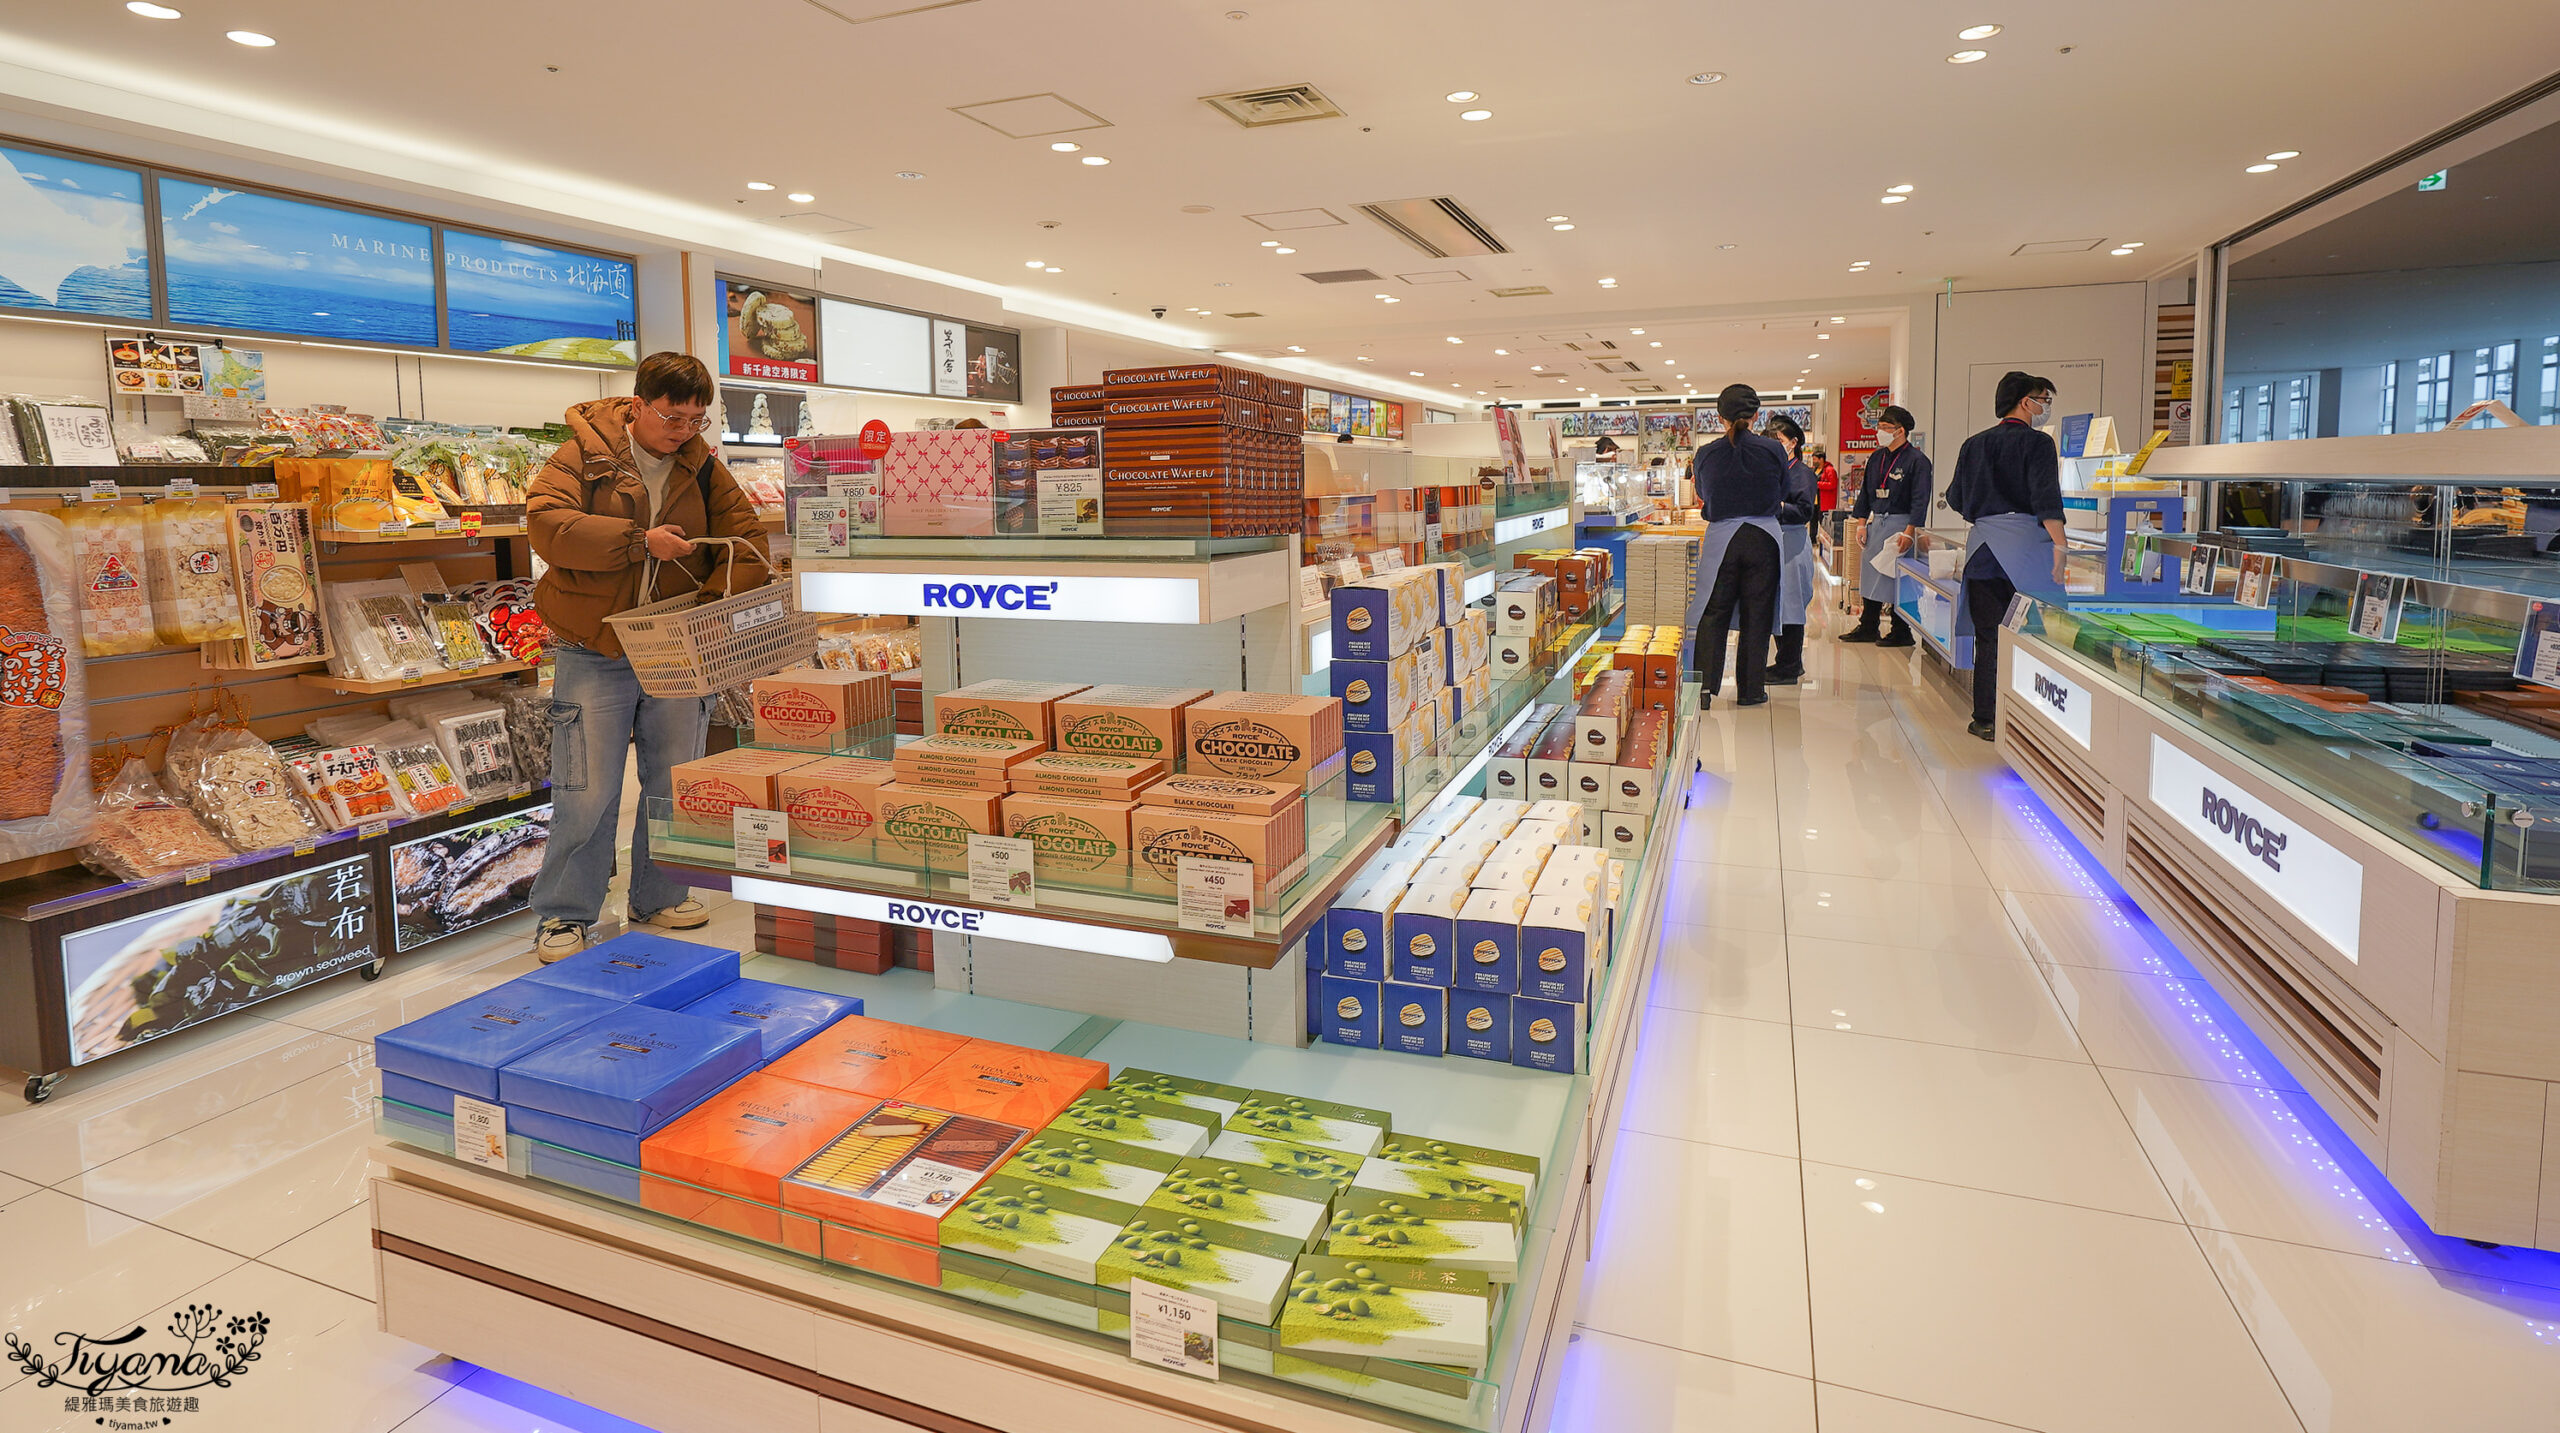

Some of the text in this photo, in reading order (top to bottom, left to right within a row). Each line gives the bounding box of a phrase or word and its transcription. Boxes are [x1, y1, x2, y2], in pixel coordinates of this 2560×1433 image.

[331, 232, 559, 283] MARINE PRODUCTS
[567, 262, 631, 299] 北海道
[742, 362, 808, 380] 新千歳空港限定
[1107, 368, 1212, 387] CHOCOLATE WAFERS
[1054, 390, 1104, 402] CHOCOLAT
[1109, 398, 1216, 415] CHOCOLATE WAFERS
[863, 427, 888, 443] 限定
[1845, 440, 1879, 449] TOMIC
[1108, 468, 1169, 482] CHOCOLATE
[1170, 465, 1215, 479] WAFERS
[843, 487, 865, 498] ¥850
[1056, 482, 1083, 494] ¥825
[811, 510, 834, 521] ¥850
[269, 512, 288, 554] 百万円
[922, 580, 1058, 611] ROYCE'
[736, 611, 781, 630] DUTY FREE SHOP
[3, 657, 23, 703] のしいか
[2034, 670, 2067, 714] ROYCE'
[764, 708, 832, 723] CHOCOLATE
[948, 725, 1029, 739] CHOCOLATE
[1070, 732, 1158, 752] CHOCOLATE
[1202, 740, 1294, 760] CHOCOLATE
[919, 753, 977, 764] ALMOND CHOCOLATE
[1236, 758, 1274, 766] CHOCOLATE
[916, 765, 976, 776] ALMOND CHOCOLATE
[1035, 772, 1098, 784] ALMOND CHOCOLATE
[920, 776, 980, 787] ALMOND CHOCOLATE
[1038, 784, 1102, 796] ALMOND CHOCOLATE
[682, 795, 755, 813] CHOCOL
[1174, 798, 1235, 810] BLACK CHOCOLATE
[790, 805, 868, 826] CHOCOLATE
[752, 822, 769, 832] ¥450
[2201, 785, 2288, 873] ROYCE'
[1181, 842, 1211, 850] ROYCE'
[991, 851, 1010, 861] ¥500
[1204, 875, 1226, 886] ¥450
[327, 865, 367, 942] 若布
[888, 902, 985, 931] ROYCE'
[275, 944, 373, 987] Brown seaweed
[923, 1170, 953, 1184] ¥1,750
[1407, 1267, 1458, 1284] 抹茶
[1158, 1303, 1191, 1321] ¥1,150
